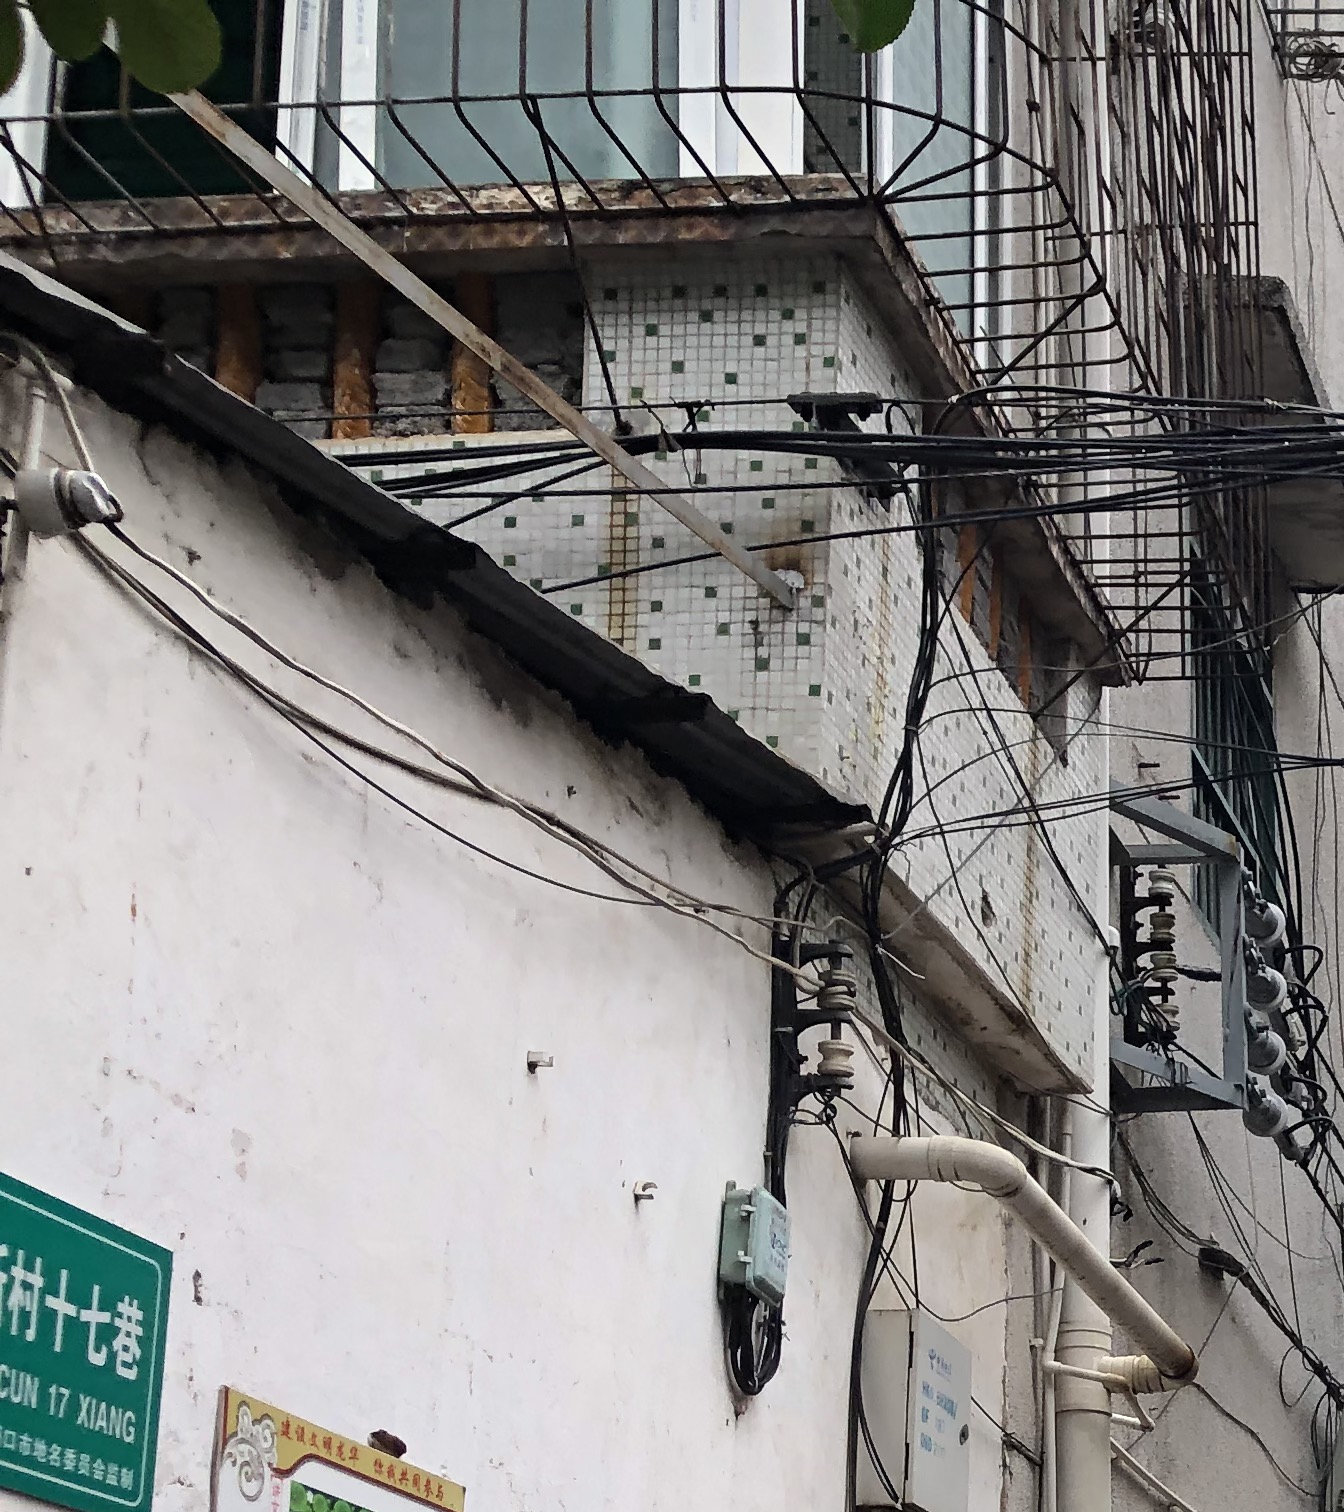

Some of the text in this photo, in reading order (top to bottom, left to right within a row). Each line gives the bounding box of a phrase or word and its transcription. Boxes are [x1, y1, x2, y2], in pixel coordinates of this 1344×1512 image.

[0, 1244, 144, 1381] 村十七巷
[49, 1383, 70, 1418] 17
[76, 1393, 136, 1444] XIANG
[0, 1425, 134, 1491] 口市地名委员会监制
